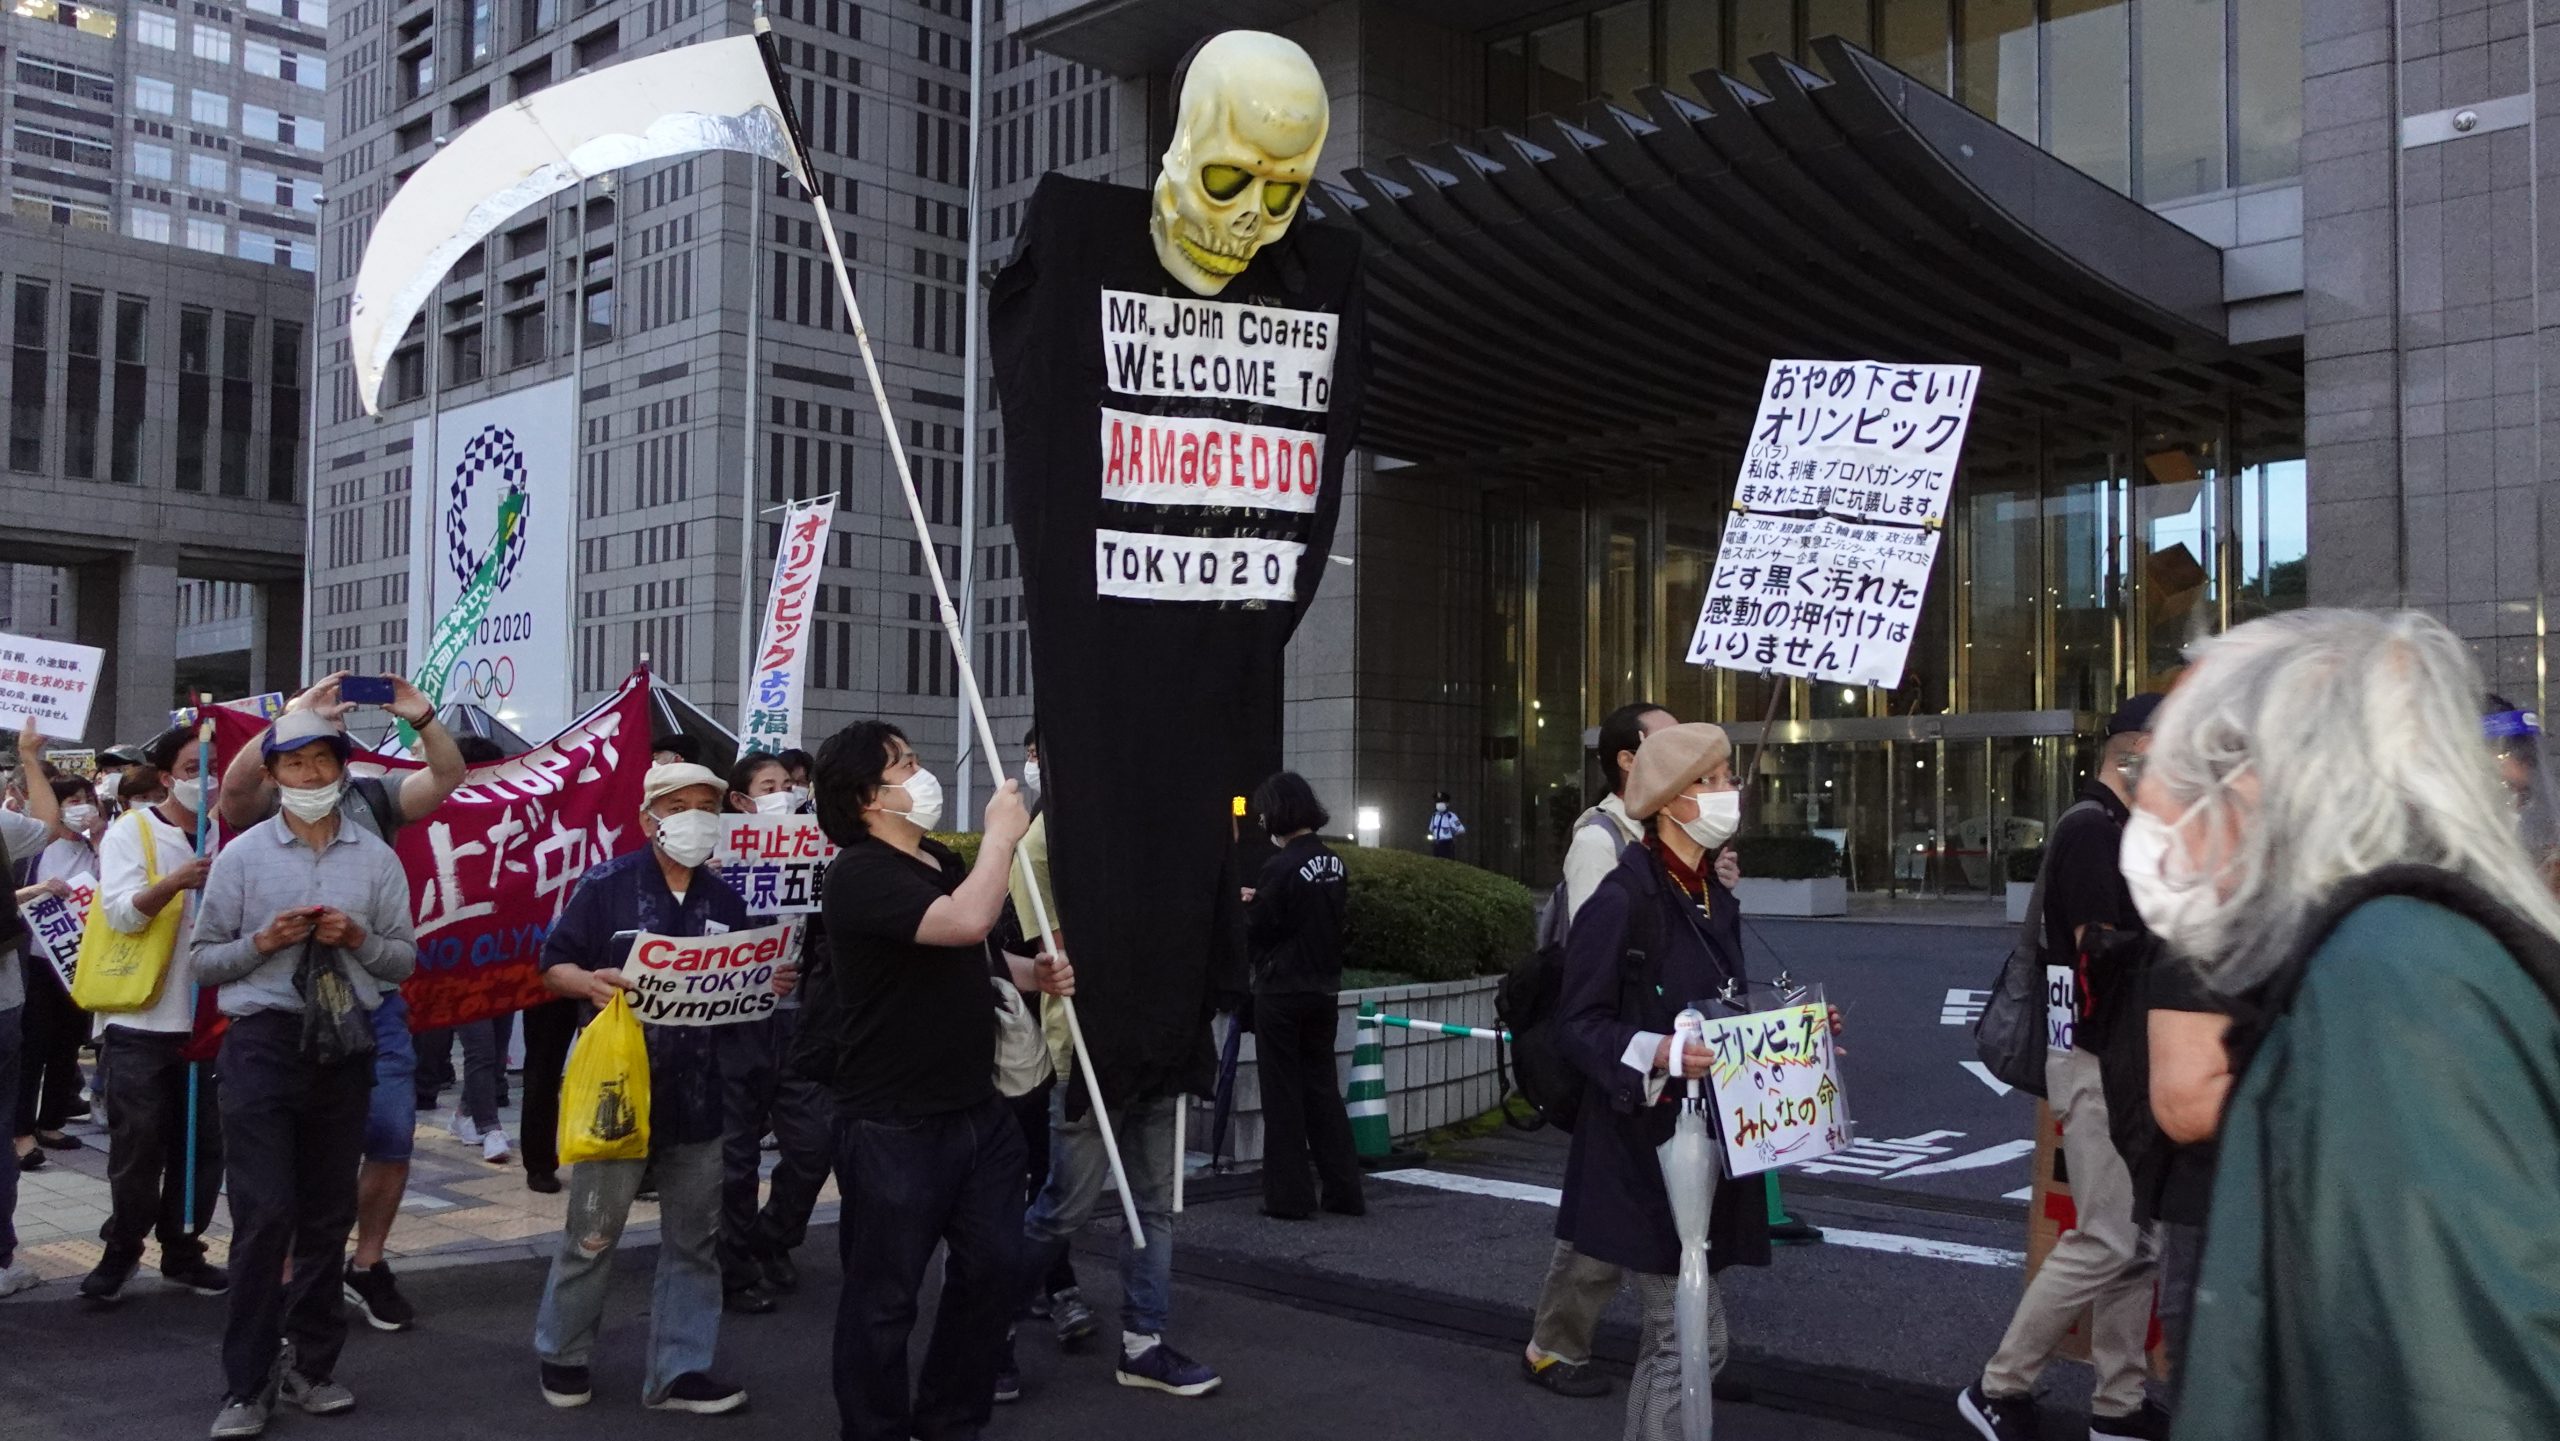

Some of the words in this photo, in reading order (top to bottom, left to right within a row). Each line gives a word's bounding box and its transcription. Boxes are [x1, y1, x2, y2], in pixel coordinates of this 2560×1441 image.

[1115, 342, 1276, 397] WELCOME
[1298, 371, 1329, 407] TO
[1770, 364, 1972, 408] おやめ下さい!
[1759, 406, 1961, 453] オリンピック
[1741, 484, 1937, 518] まみれた五輪に抗議します。
[1715, 564, 1918, 609] どす黒く汚れた
[493, 612, 531, 644] 2020
[1704, 596, 1910, 642] 感動の押付けは
[1696, 630, 1859, 675] いりません!
[0, 669, 88, 693] 延期を求めます
[0, 701, 68, 721] してはいけません
[638, 926, 791, 971] Cancel
[638, 974, 676, 993] the
[685, 965, 772, 994] TOKYO
[624, 989, 776, 1021] Olympics
[1734, 1073, 1838, 1147] みんなの命
